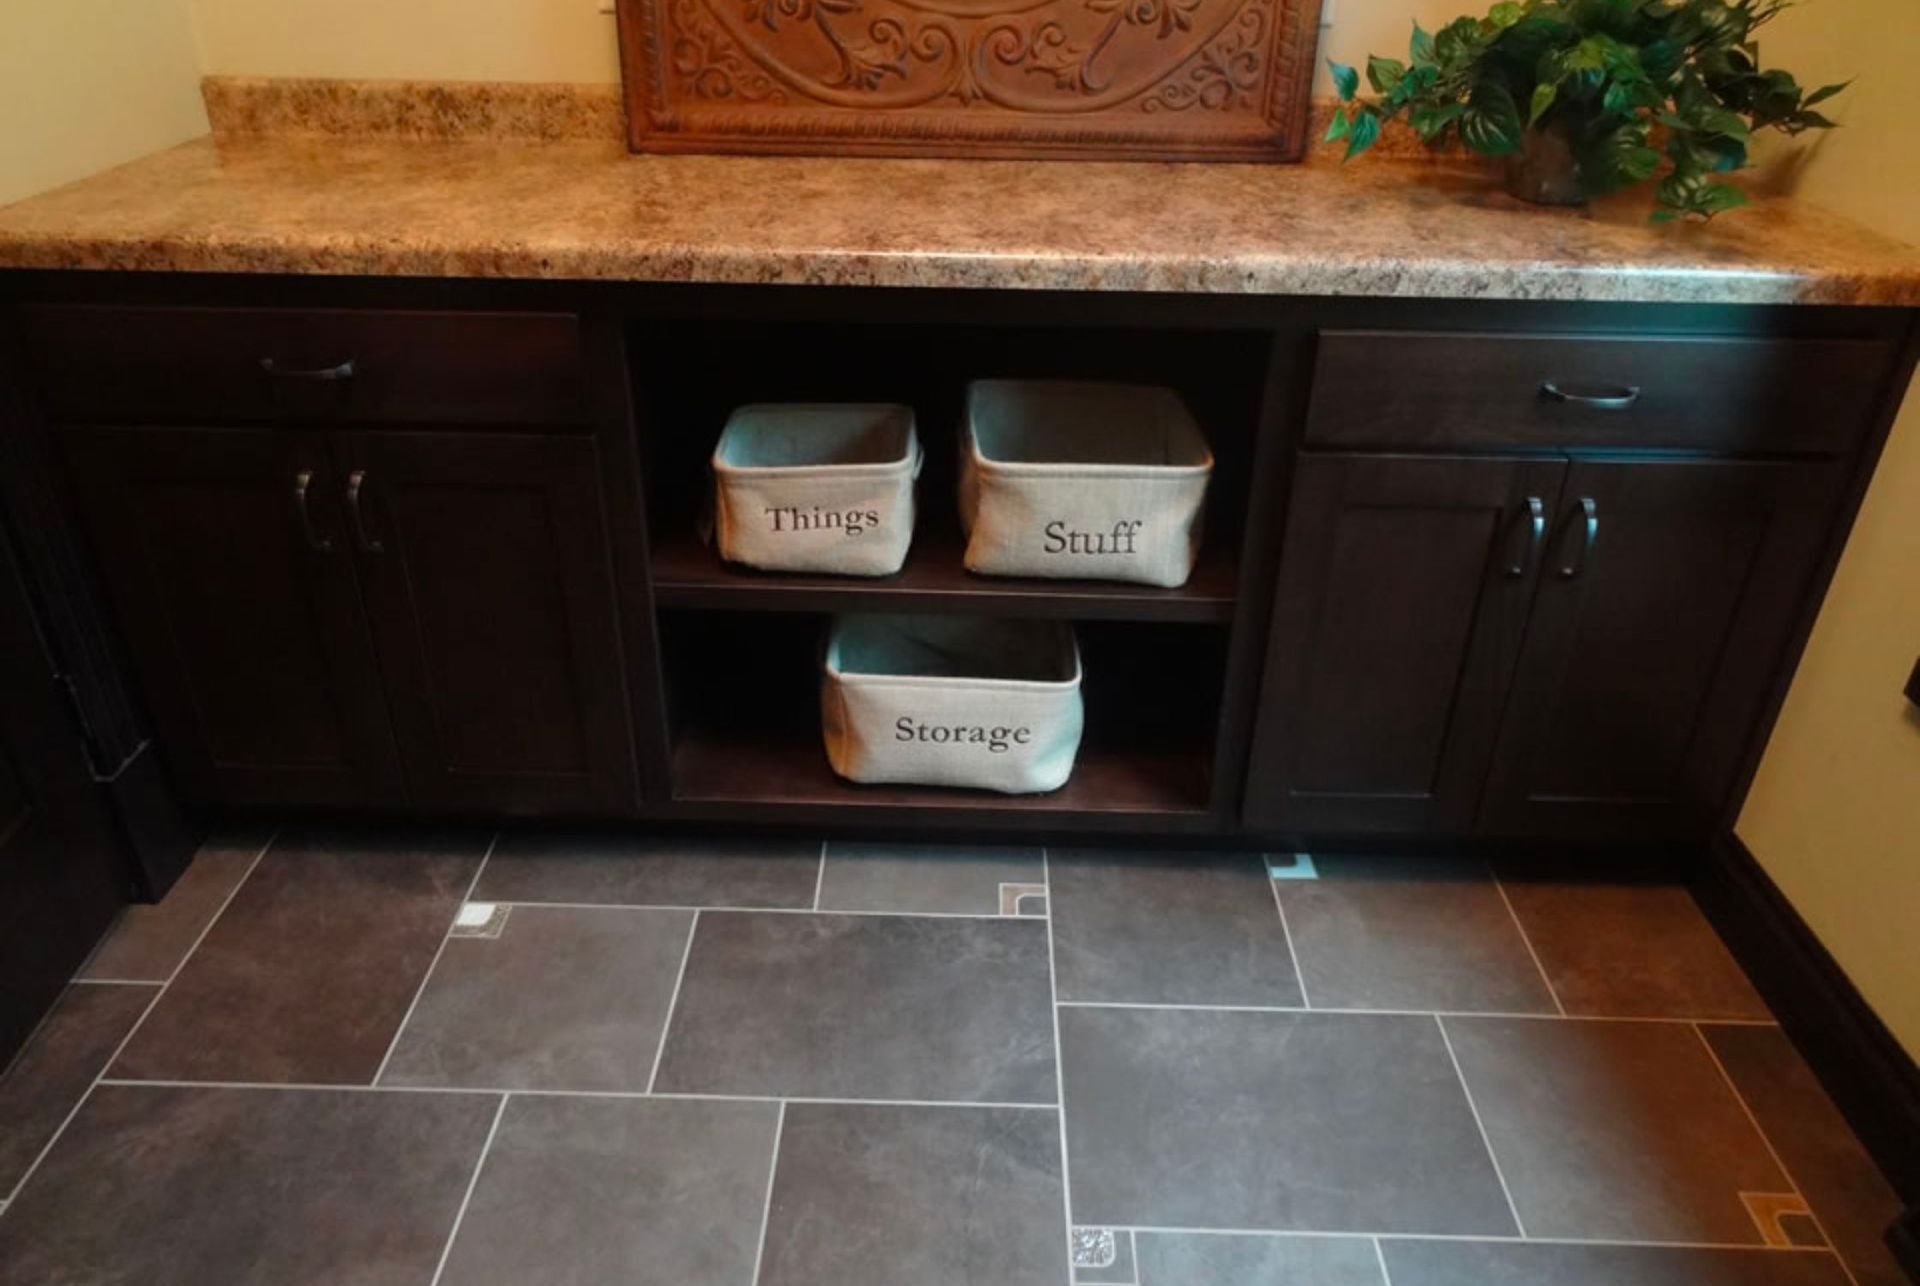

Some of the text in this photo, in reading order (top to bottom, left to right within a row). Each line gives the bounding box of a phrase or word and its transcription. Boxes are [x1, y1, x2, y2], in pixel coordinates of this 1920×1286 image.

[764, 505, 880, 536] Things
[1043, 520, 1143, 556] Stuff
[895, 716, 1031, 753] Storage
